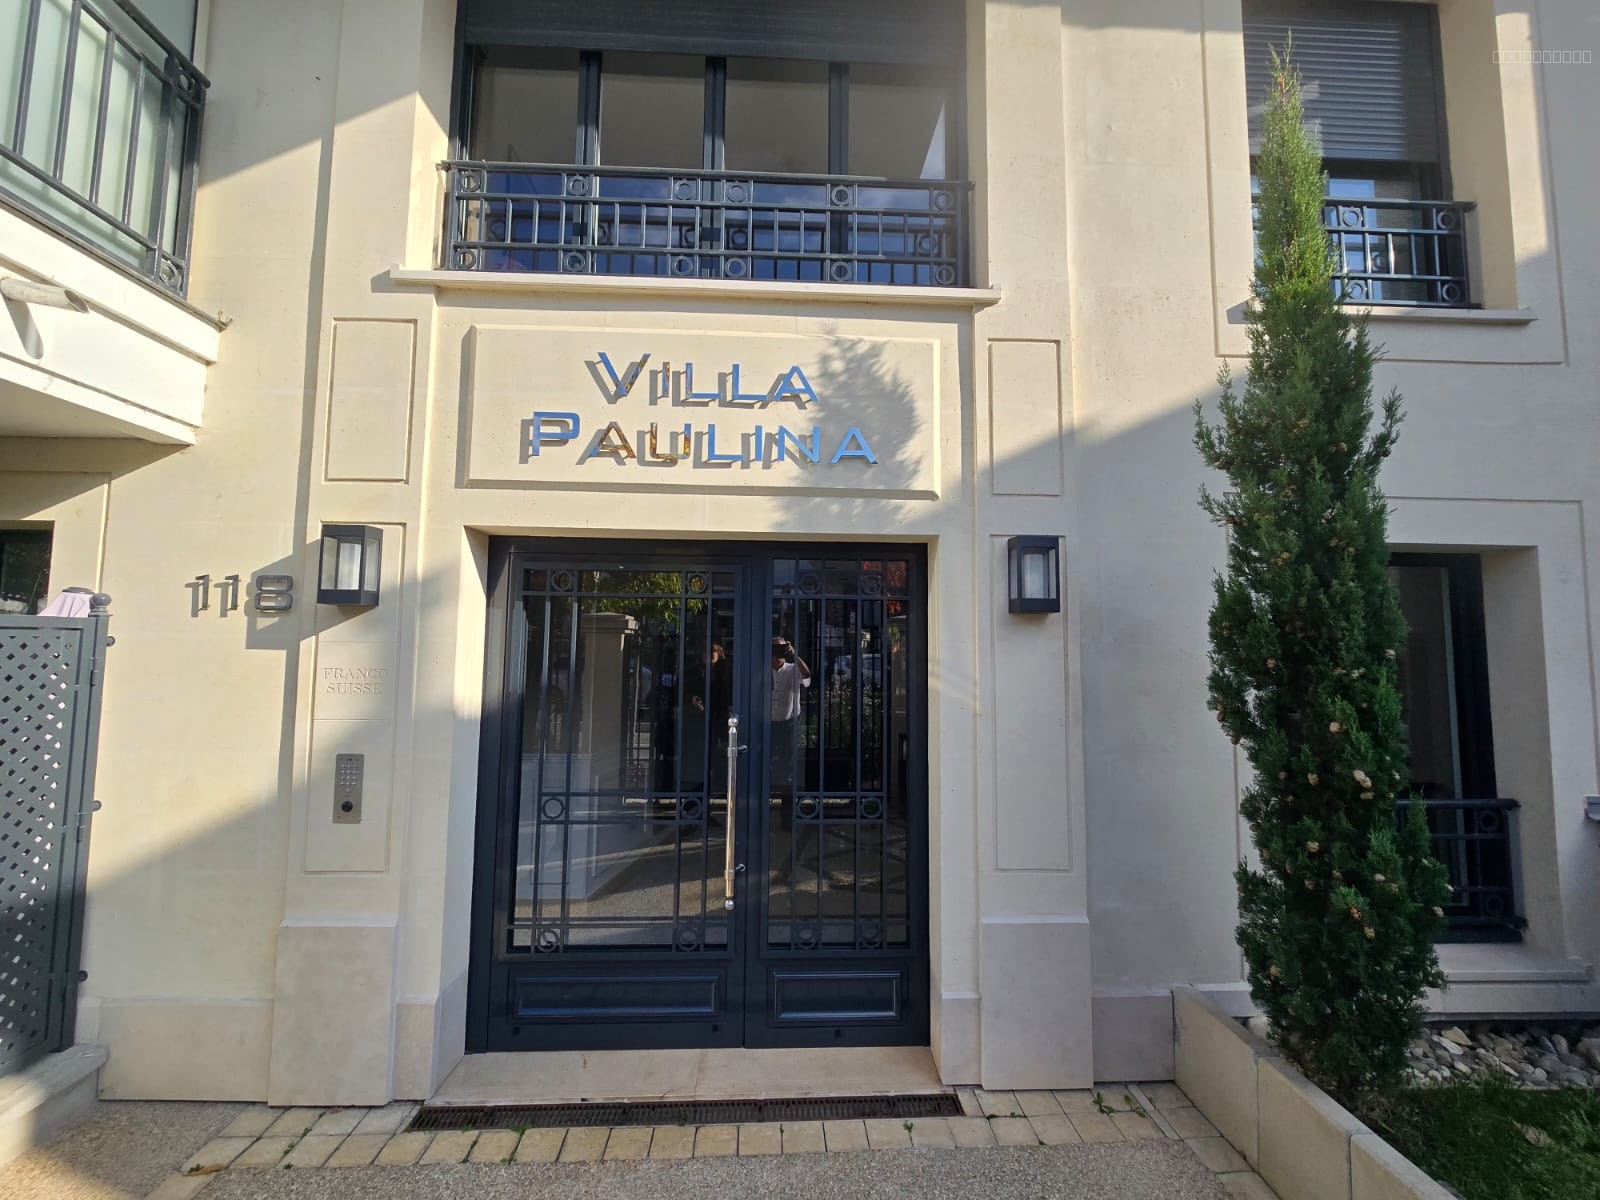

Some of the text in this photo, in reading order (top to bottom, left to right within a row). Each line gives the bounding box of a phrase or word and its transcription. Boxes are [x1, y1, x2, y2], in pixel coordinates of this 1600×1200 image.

[597, 352, 819, 401] VILLA
[532, 411, 878, 465] PAULINA
[194, 574, 293, 610] 118
[326, 682, 384, 695] SUISSE
